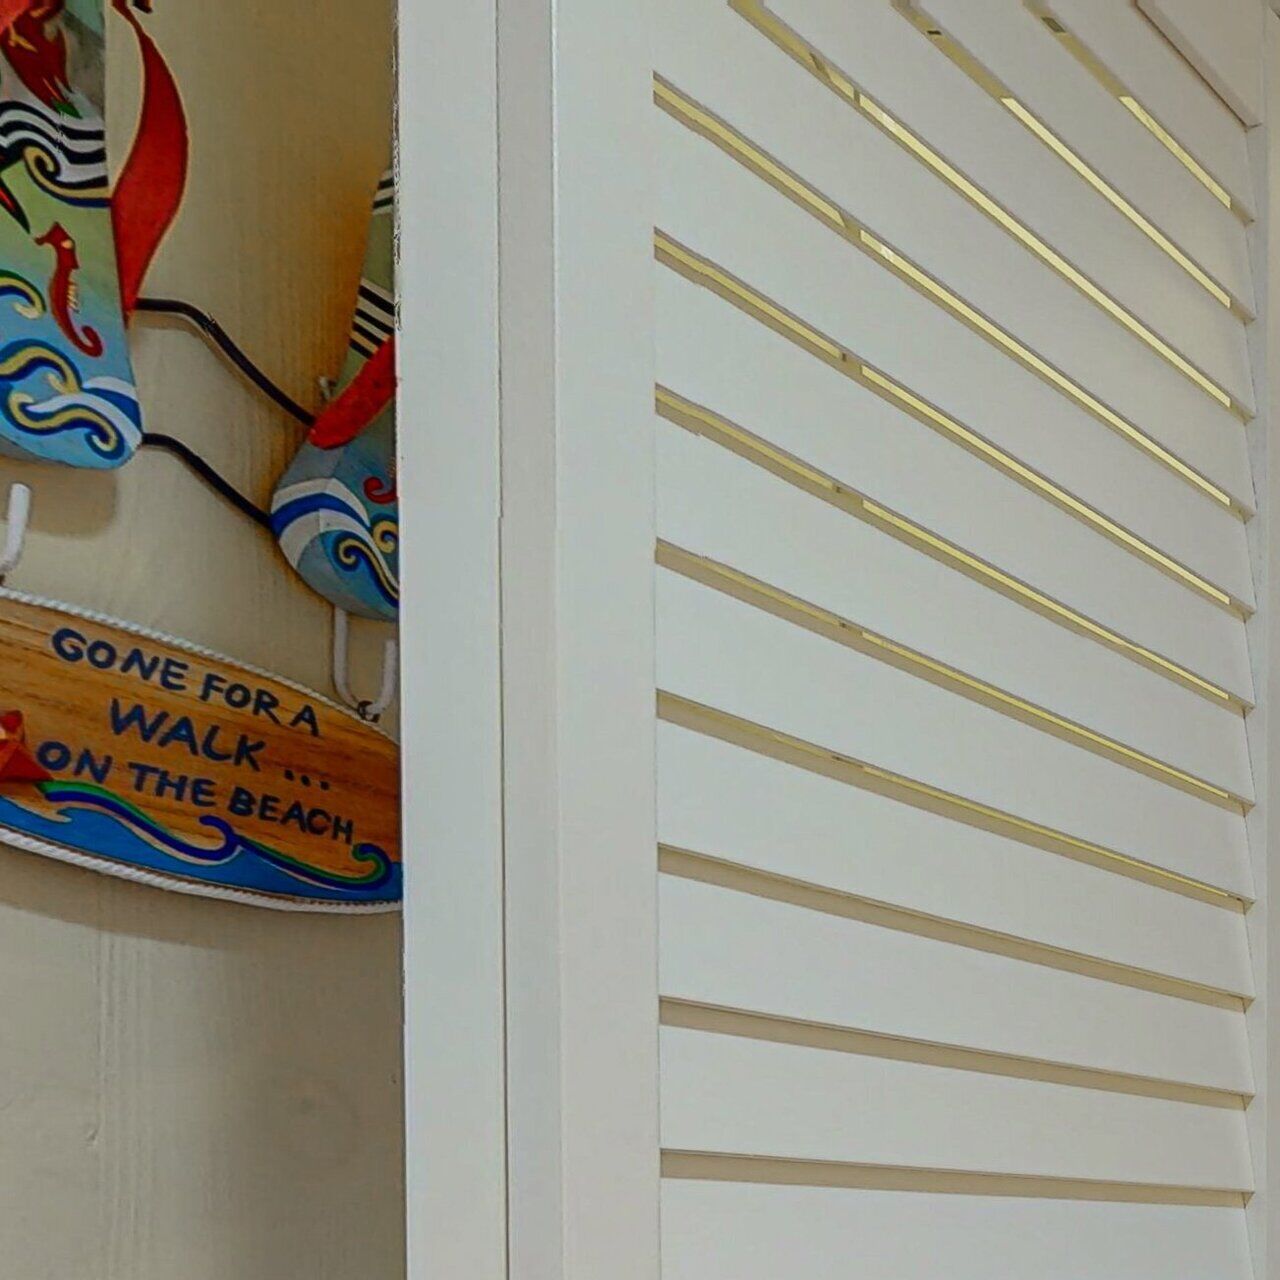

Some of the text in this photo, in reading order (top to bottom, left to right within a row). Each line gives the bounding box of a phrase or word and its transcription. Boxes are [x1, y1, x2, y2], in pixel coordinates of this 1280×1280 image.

[51, 627, 321, 738] GONE FOR A
[109, 698, 267, 772] WALK
[35, 741, 355, 846] ON THE BEACH
